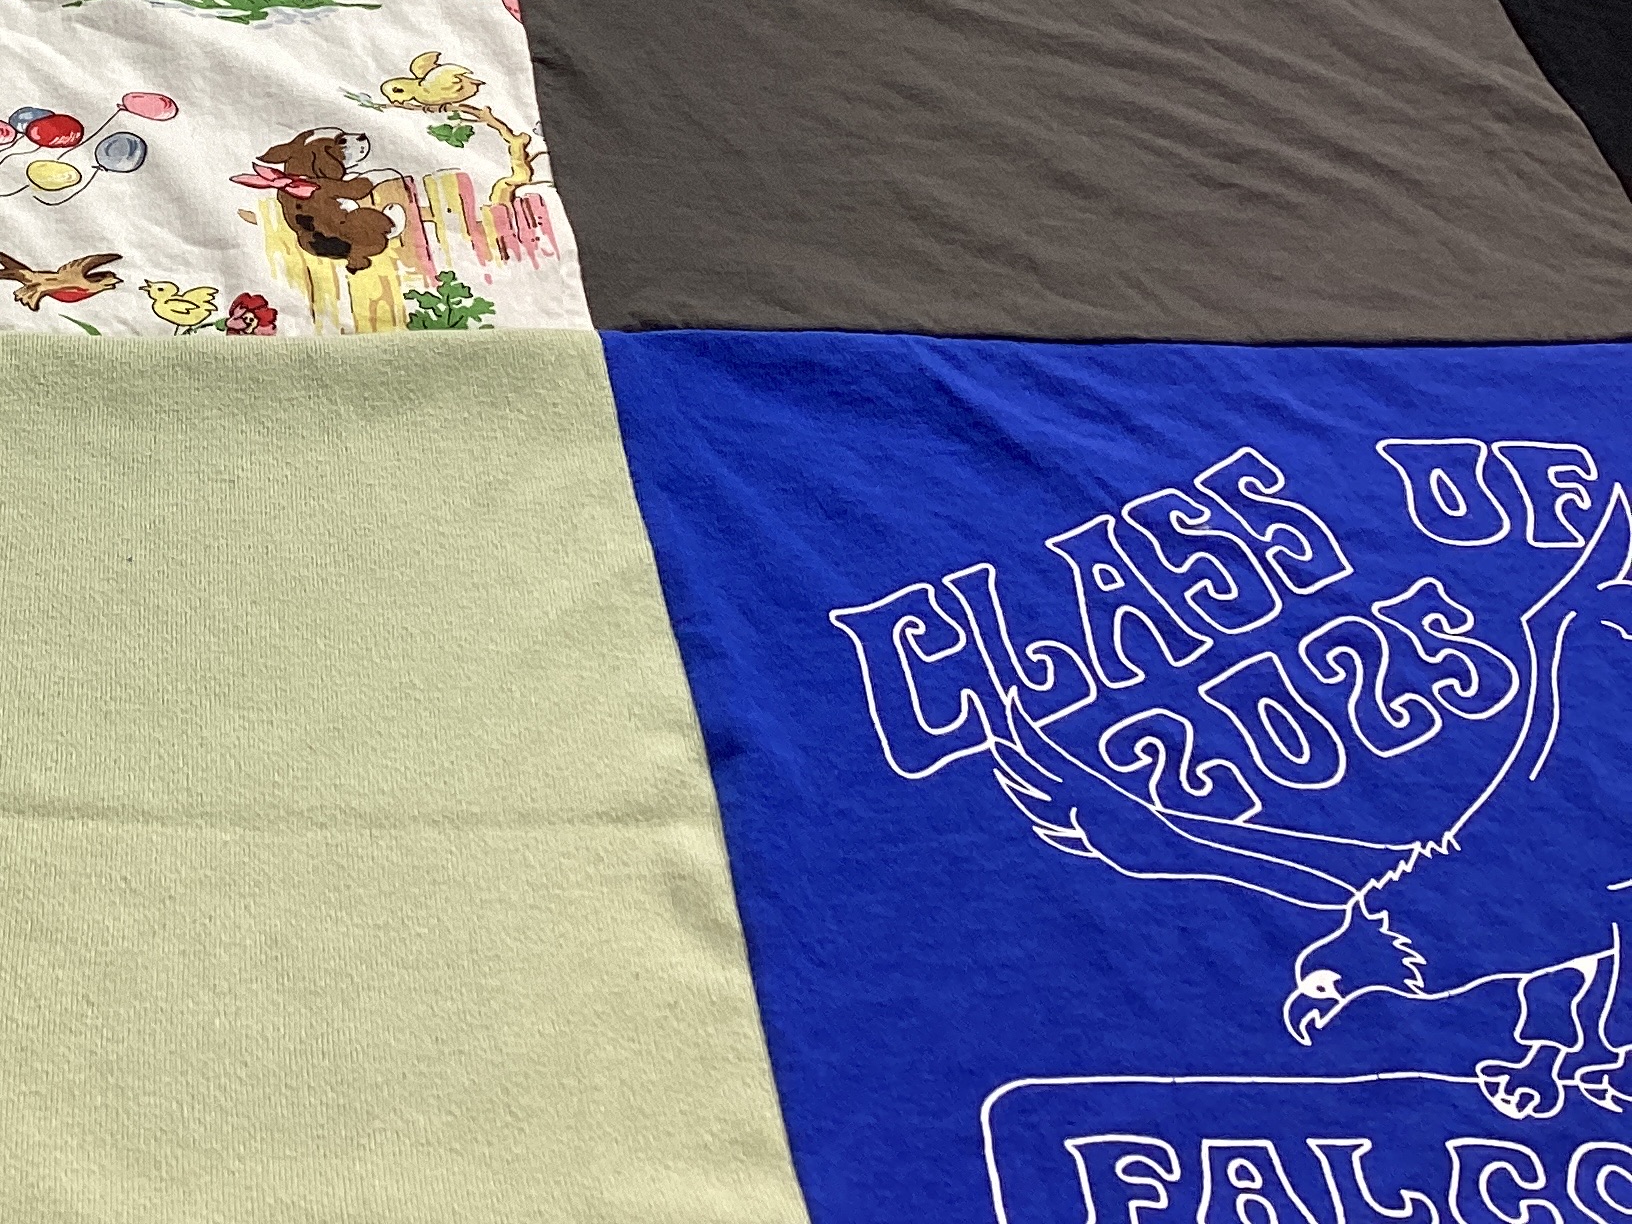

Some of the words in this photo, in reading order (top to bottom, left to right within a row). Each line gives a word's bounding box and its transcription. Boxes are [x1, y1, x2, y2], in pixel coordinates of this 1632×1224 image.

[829, 447, 1355, 779] CLASS
[1376, 438, 1598, 548] OF
[1098, 576, 1520, 824] 2025
